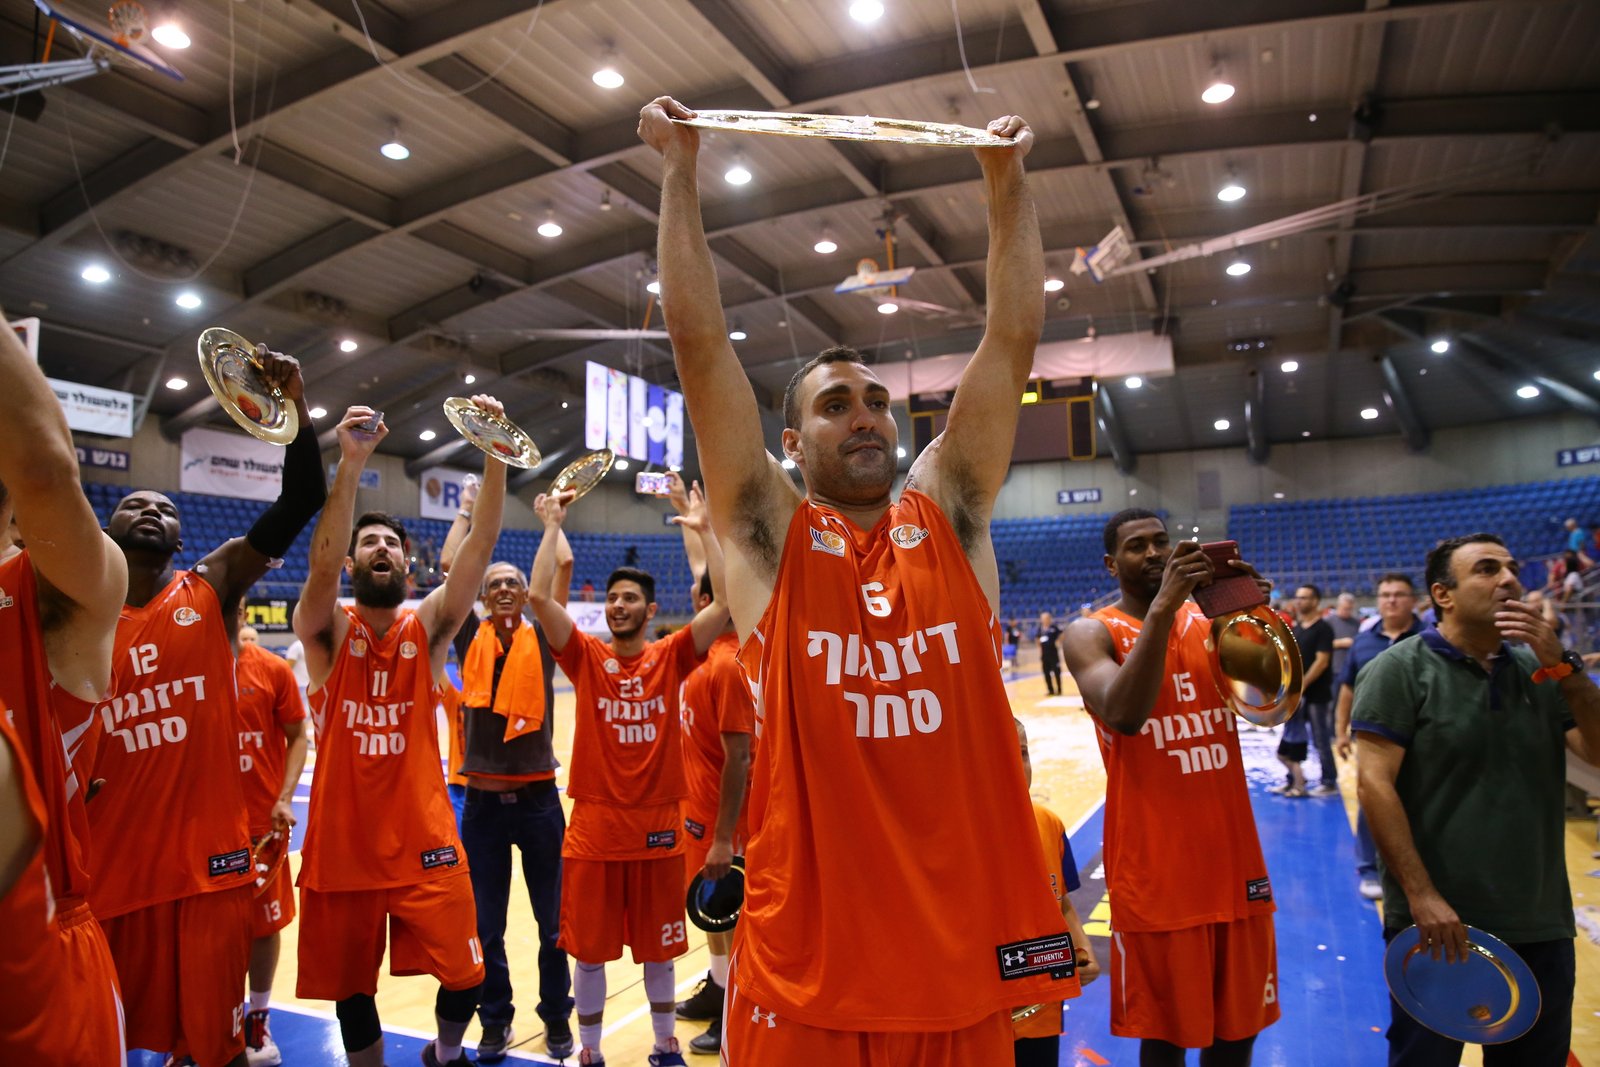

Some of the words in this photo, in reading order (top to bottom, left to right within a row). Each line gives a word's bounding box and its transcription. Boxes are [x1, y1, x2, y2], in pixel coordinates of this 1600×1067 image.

[92, 450, 127, 468] גוש
[861, 581, 892, 617] 6
[129, 643, 159, 676] 12
[807, 621, 961, 685] דיזנגוף
[372, 670, 388, 697] 11
[620, 676, 645, 698] 23
[1172, 672, 1197, 702] 15
[843, 689, 943, 738] סחר
[111, 716, 188, 753] סחר
[353, 731, 406, 756] סחר
[612, 723, 657, 744] סחר
[1167, 743, 1229, 774] סחר
[264, 900, 282, 923] 13
[661, 920, 686, 946] 23
[1027, 944, 1044, 952] UNDER
[1044, 941, 1066, 949] ARMOUR
[1033, 952, 1064, 964] AUTHENTIC
